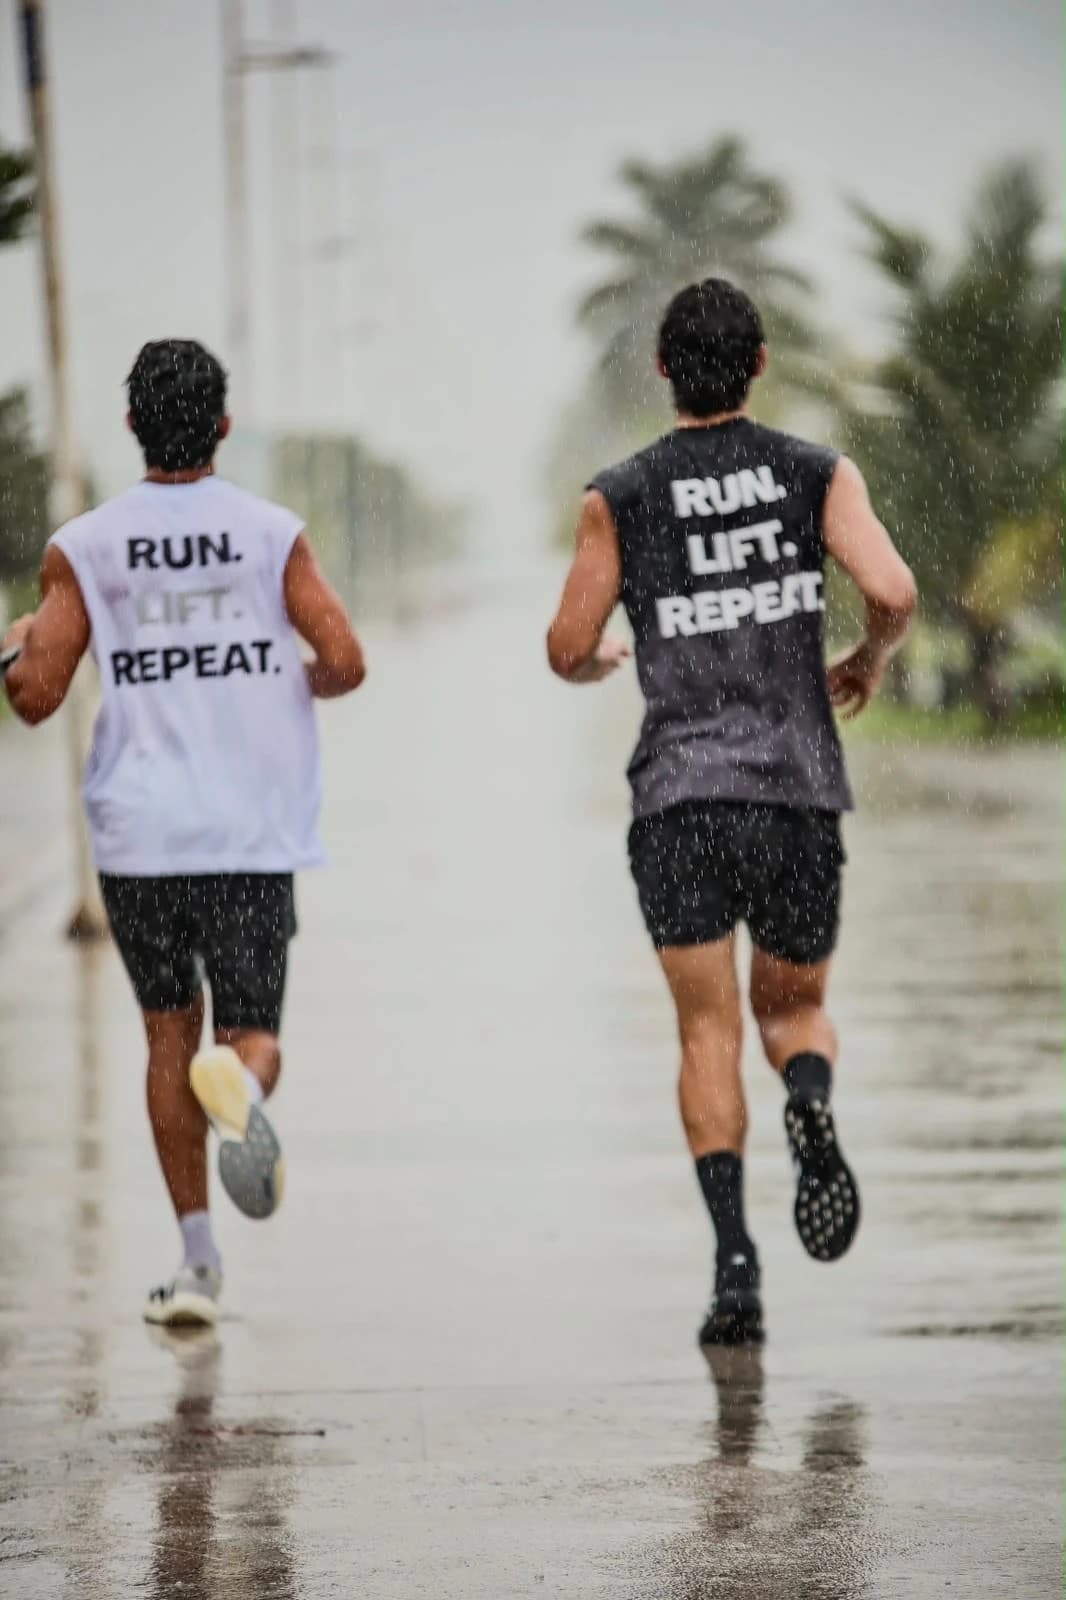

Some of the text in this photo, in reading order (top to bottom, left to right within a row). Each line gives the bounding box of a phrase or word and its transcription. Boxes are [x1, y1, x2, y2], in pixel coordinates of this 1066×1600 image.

[670, 465, 787, 518] RUN.
[127, 532, 243, 570] RUN.
[687, 519, 798, 576] LIFT.
[137, 585, 243, 625] LIFT.
[655, 571, 826, 639] REPEAT.
[111, 640, 281, 686] REPEAT.
